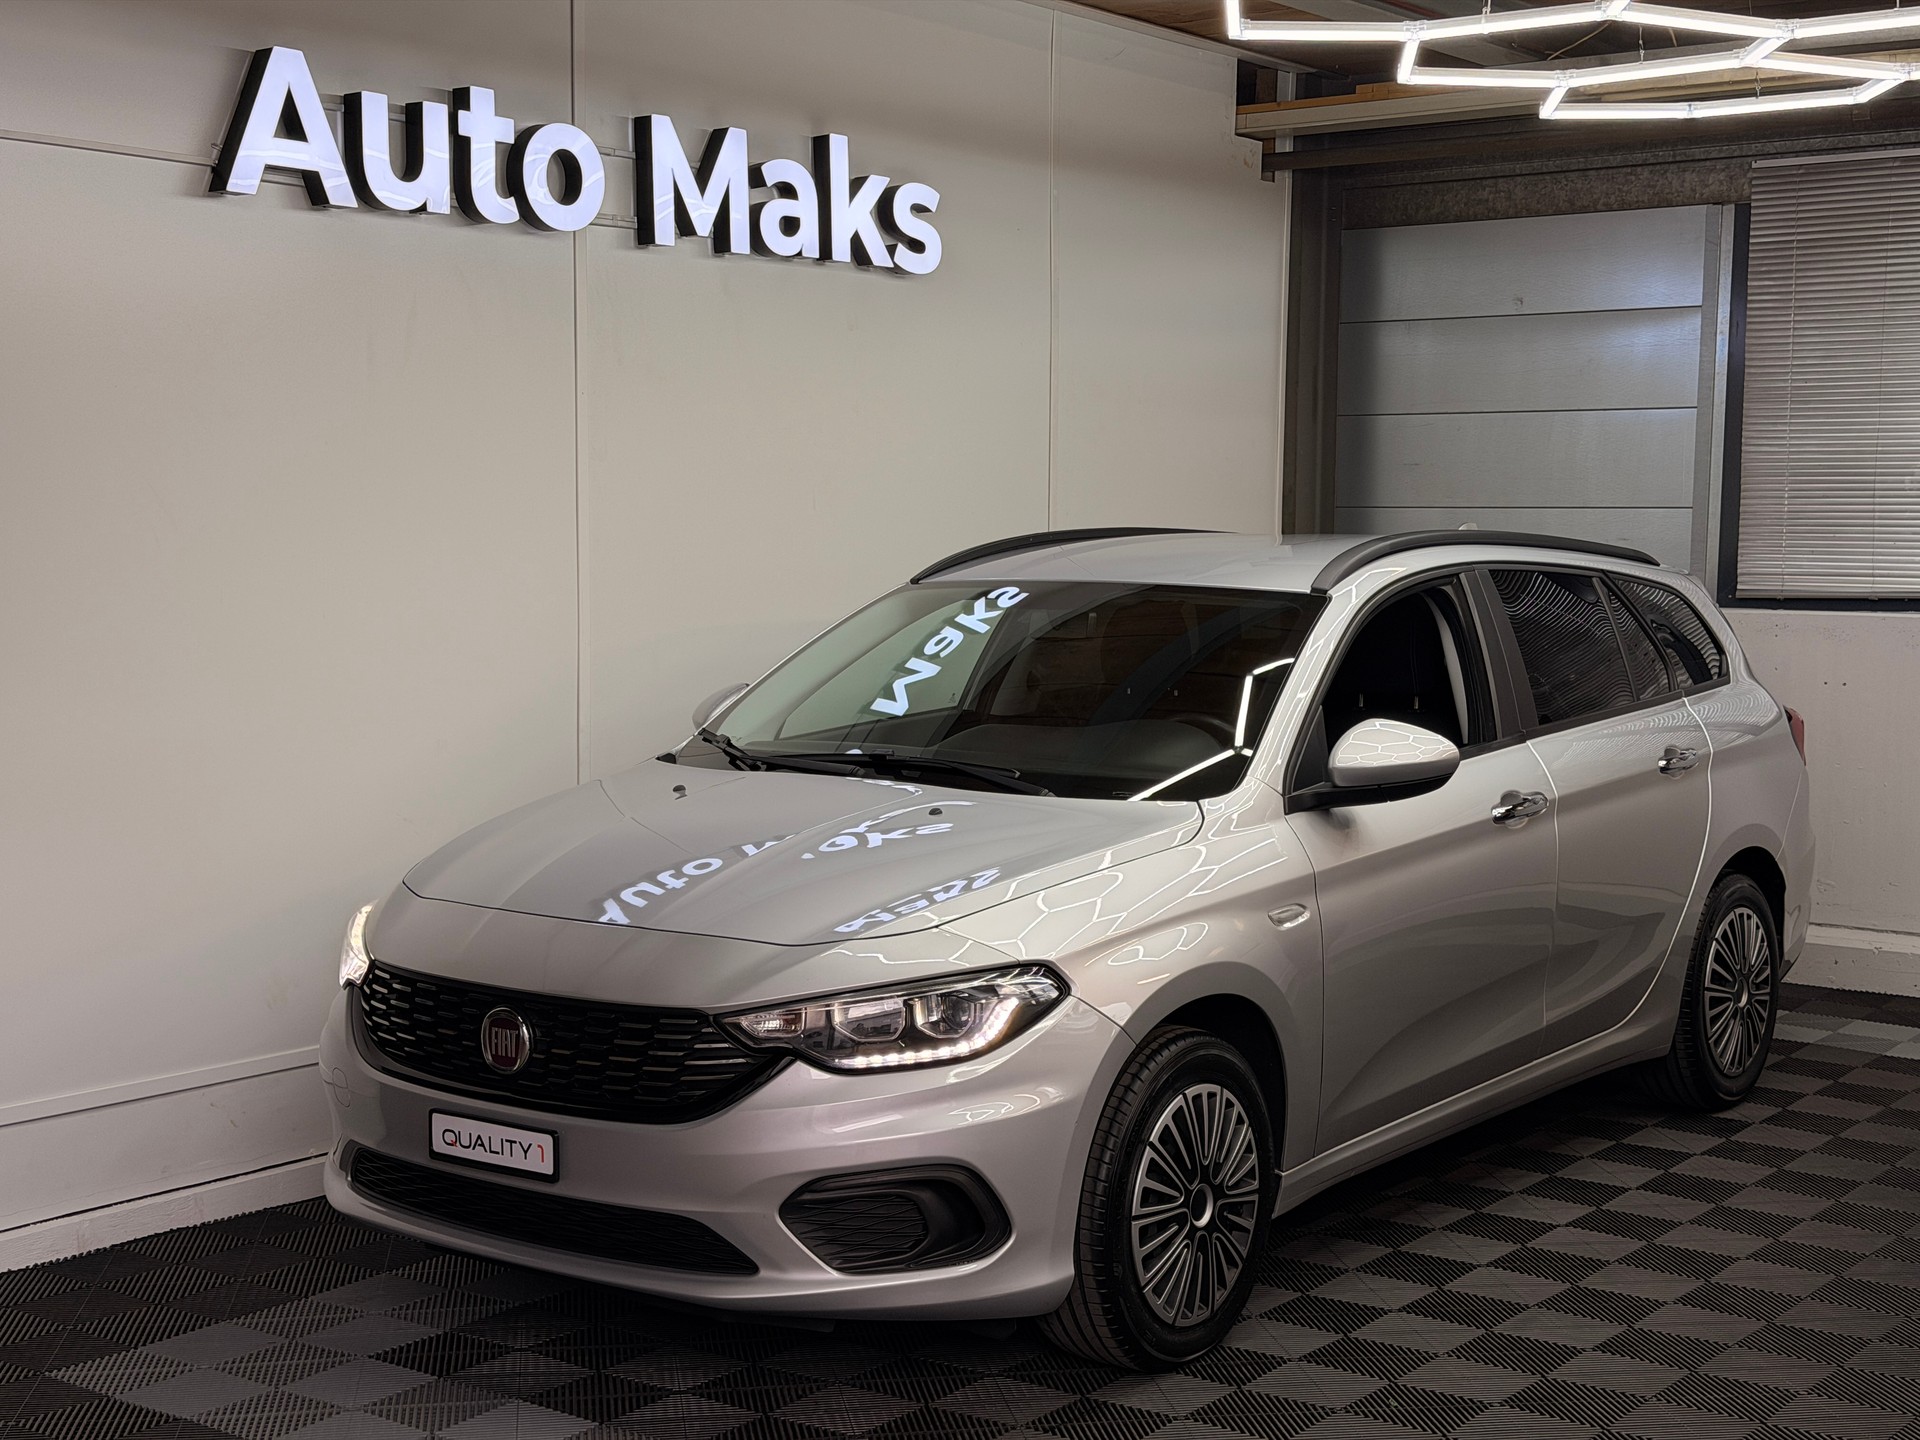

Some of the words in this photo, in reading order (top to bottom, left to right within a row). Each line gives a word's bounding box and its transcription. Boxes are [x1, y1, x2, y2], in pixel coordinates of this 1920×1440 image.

[222, 45, 606, 232] Auto
[646, 113, 943, 276] Maks
[491, 1026, 519, 1058] FIAT
[441, 1128, 533, 1160] QUALITY
[537, 1143, 545, 1163] 1
